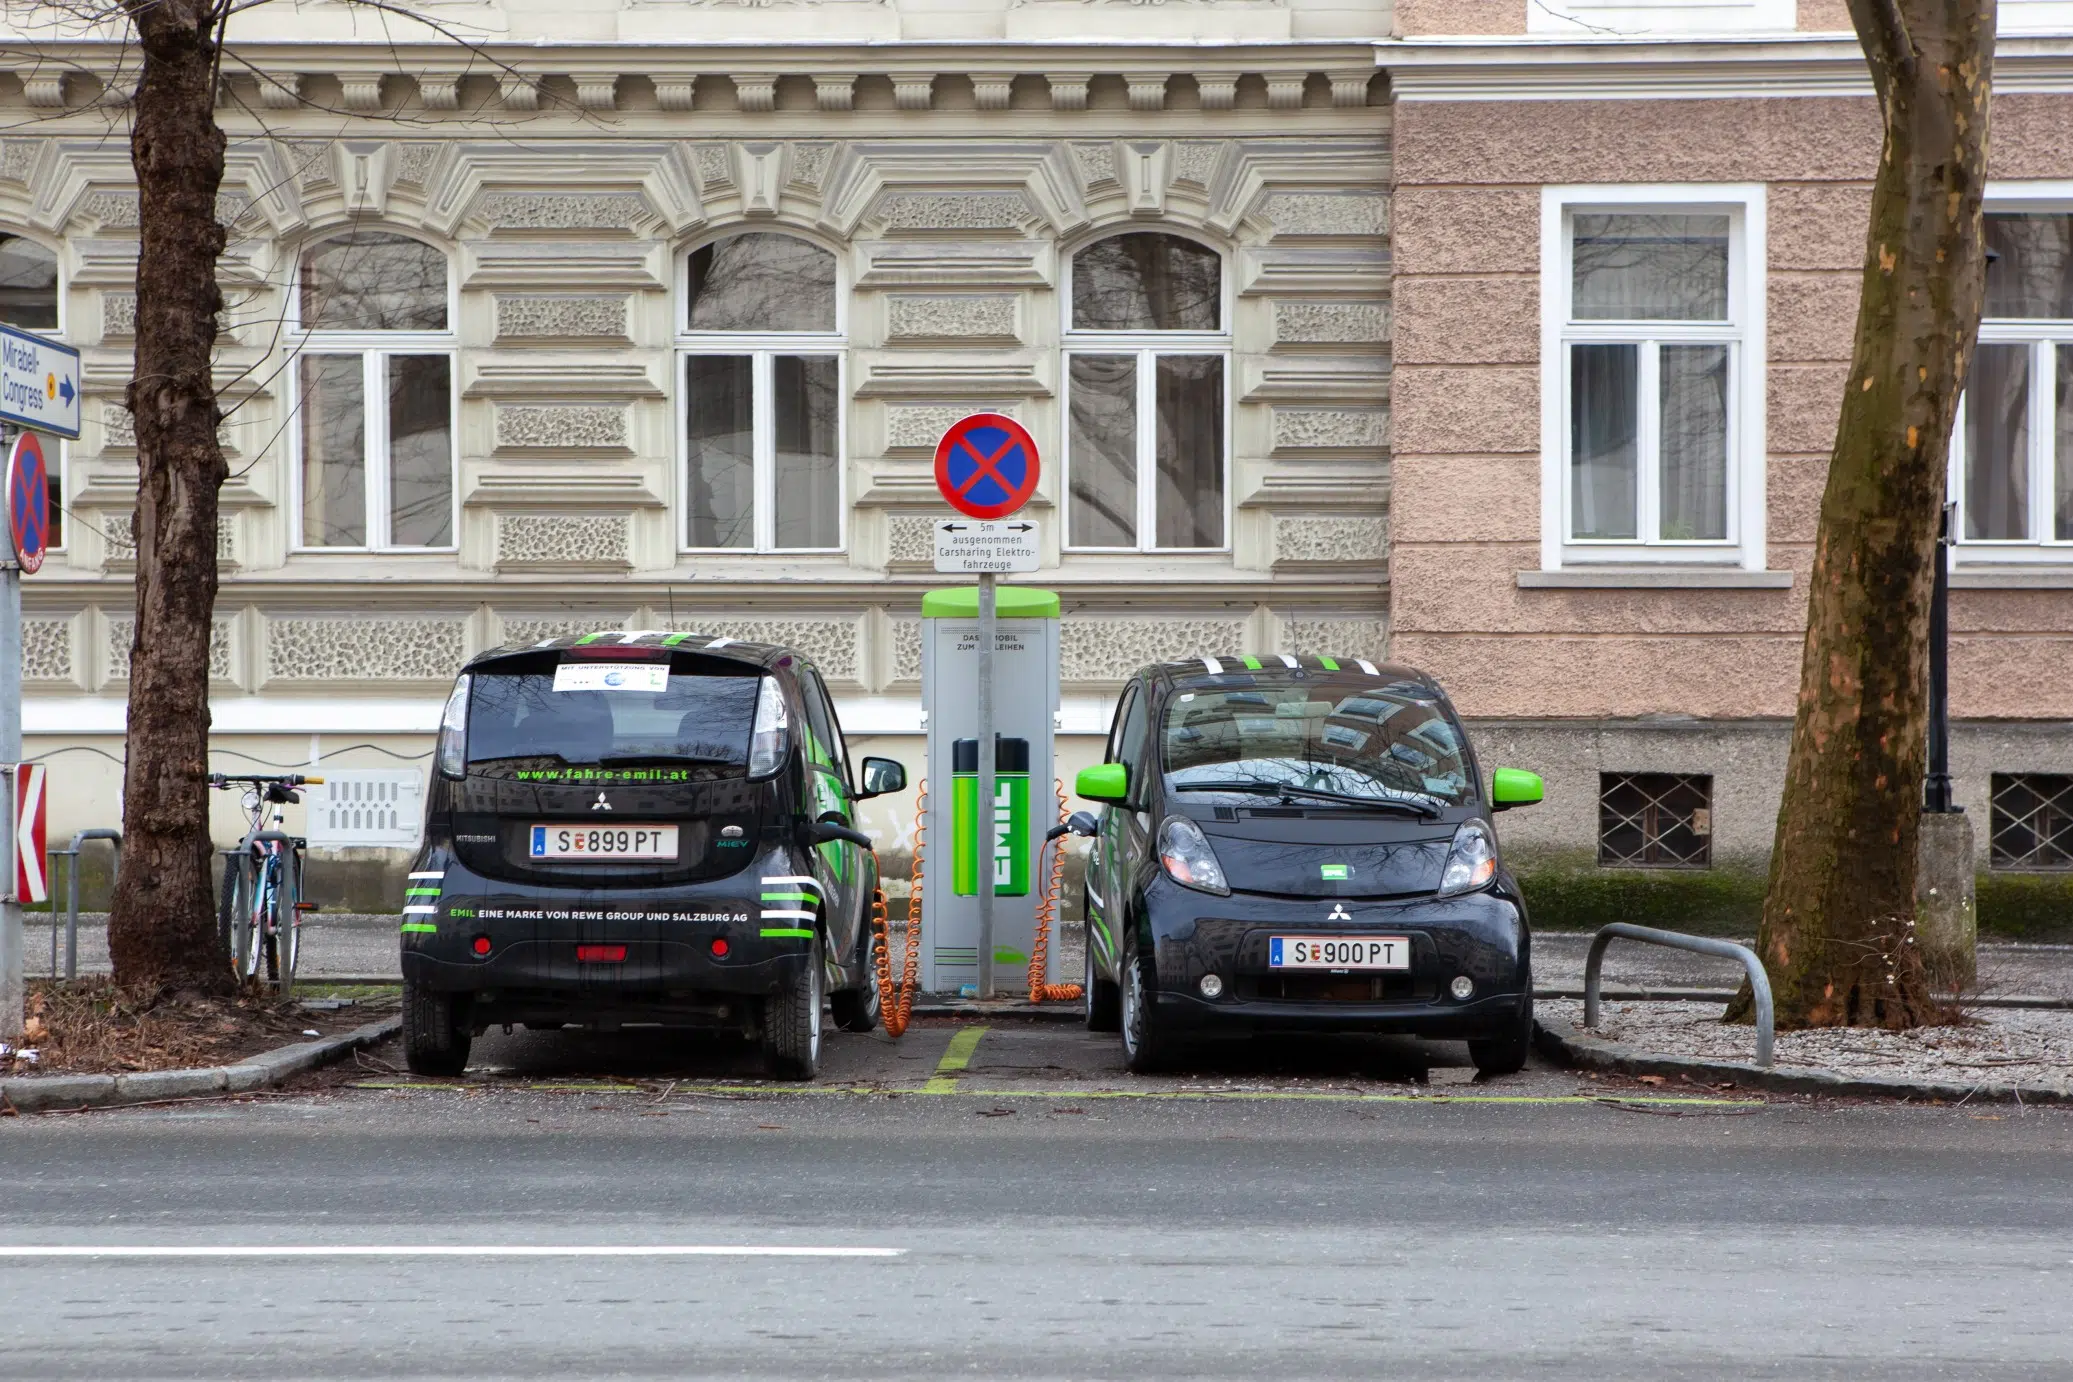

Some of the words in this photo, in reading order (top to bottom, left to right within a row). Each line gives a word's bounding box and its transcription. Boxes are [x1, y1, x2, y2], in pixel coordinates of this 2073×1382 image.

[3, 337, 40, 375] Mirabell-
[3, 371, 43, 412] Congress
[980, 522, 995, 532] 5m
[953, 536, 1022, 546] ausgenommen
[20, 547, 44, 569] ANFANG
[940, 547, 992, 558] Carsharing
[996, 547, 1035, 557] Elektro-
[963, 559, 1012, 570] fahrzeuge
[957, 643, 975, 651] ZUM
[517, 768, 688, 780] www.fahre-emil.at
[456, 834, 496, 843] MITSUBISHI
[535, 844, 543, 852] A
[558, 830, 570, 852] S
[450, 908, 475, 918] EMIL
[478, 909, 504, 918] EINE
[506, 910, 543, 919] MARKE
[546, 910, 569, 920] VON
[572, 911, 604, 920] REWE
[606, 912, 644, 921] GROUP
[647, 912, 670, 921] UND
[672, 913, 730, 922] SALZBURG
[732, 913, 748, 922] AG
[1295, 942, 1307, 963] S
